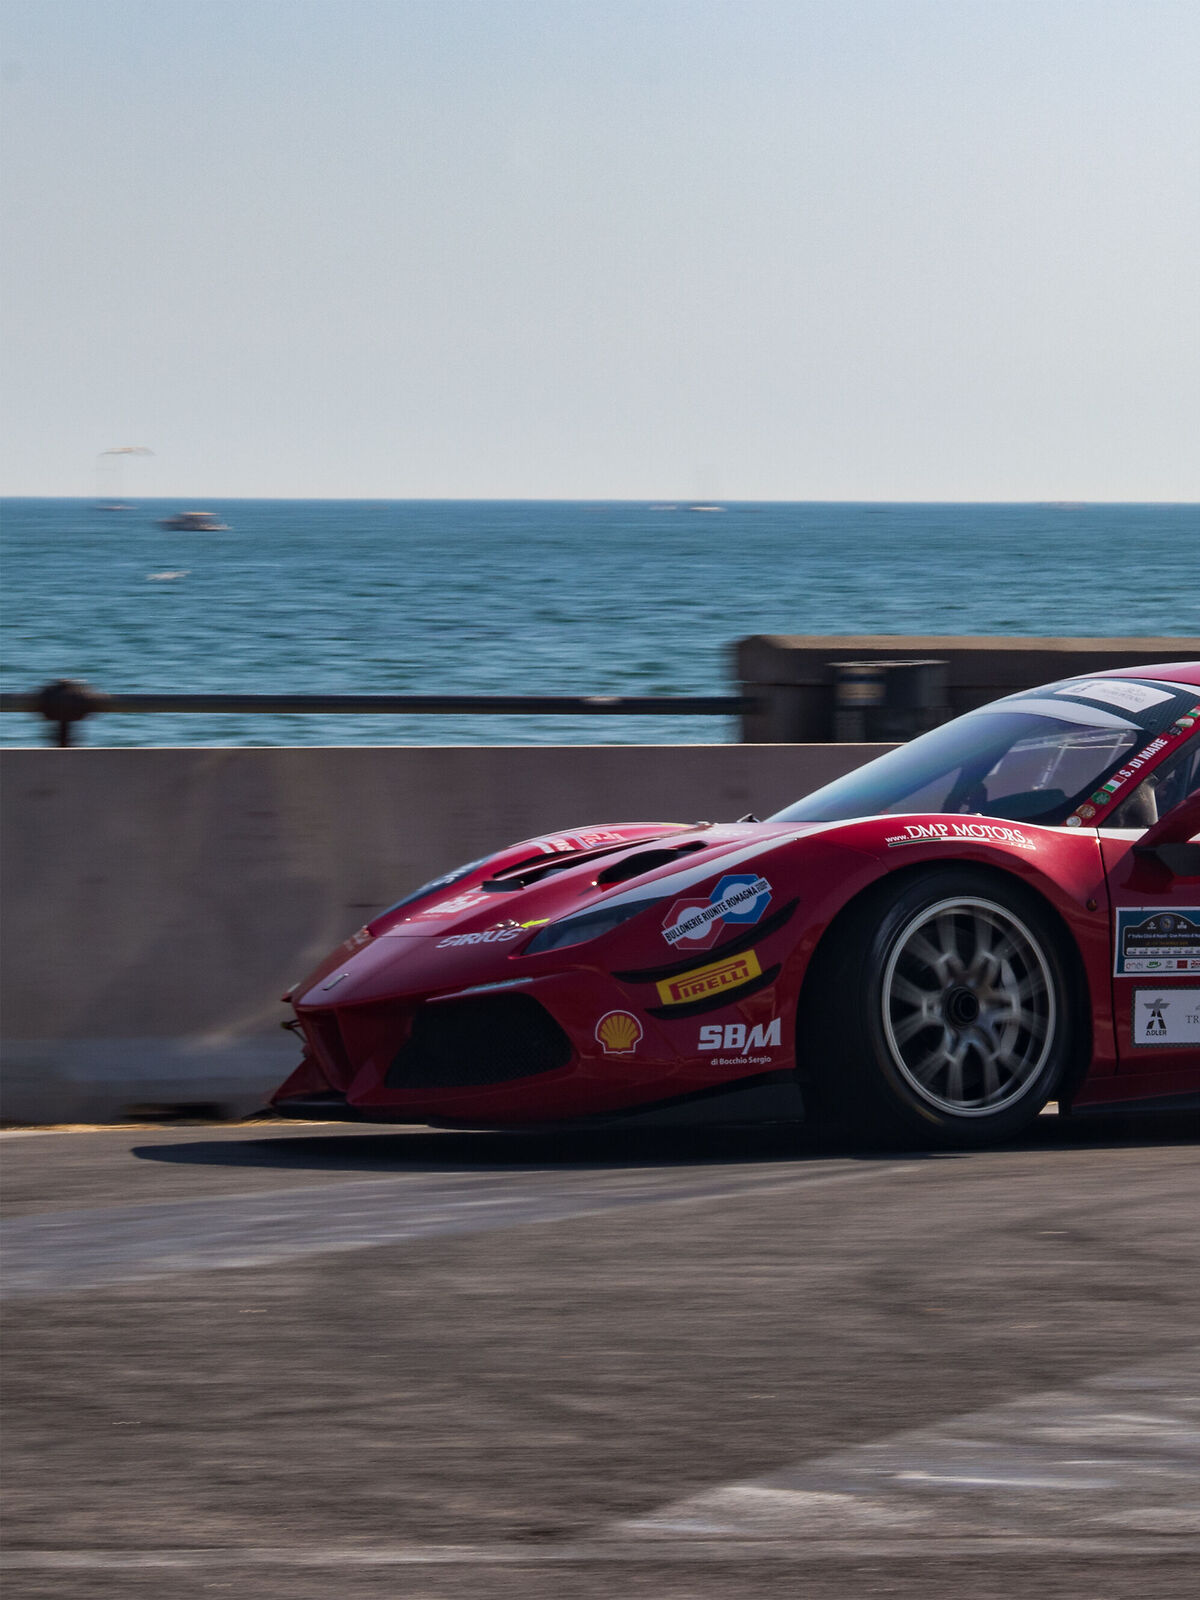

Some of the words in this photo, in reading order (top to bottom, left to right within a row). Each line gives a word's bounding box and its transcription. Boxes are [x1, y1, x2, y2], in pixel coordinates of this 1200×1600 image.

[1119, 769, 1135, 778] S.
[1128, 753, 1145, 769] DI
[1140, 738, 1168, 760] MARE
[664, 915, 704, 942] BULLONERIE
[701, 903, 728, 922] RIUNITE
[726, 886, 758, 910] ROMAGNA
[435, 928, 525, 948] SIRIUS
[669, 960, 750, 1001] PIRELLI
[697, 1017, 781, 1055] SBM
[719, 1057, 747, 1065] Bocchio
[748, 1056, 772, 1065] Sergio
